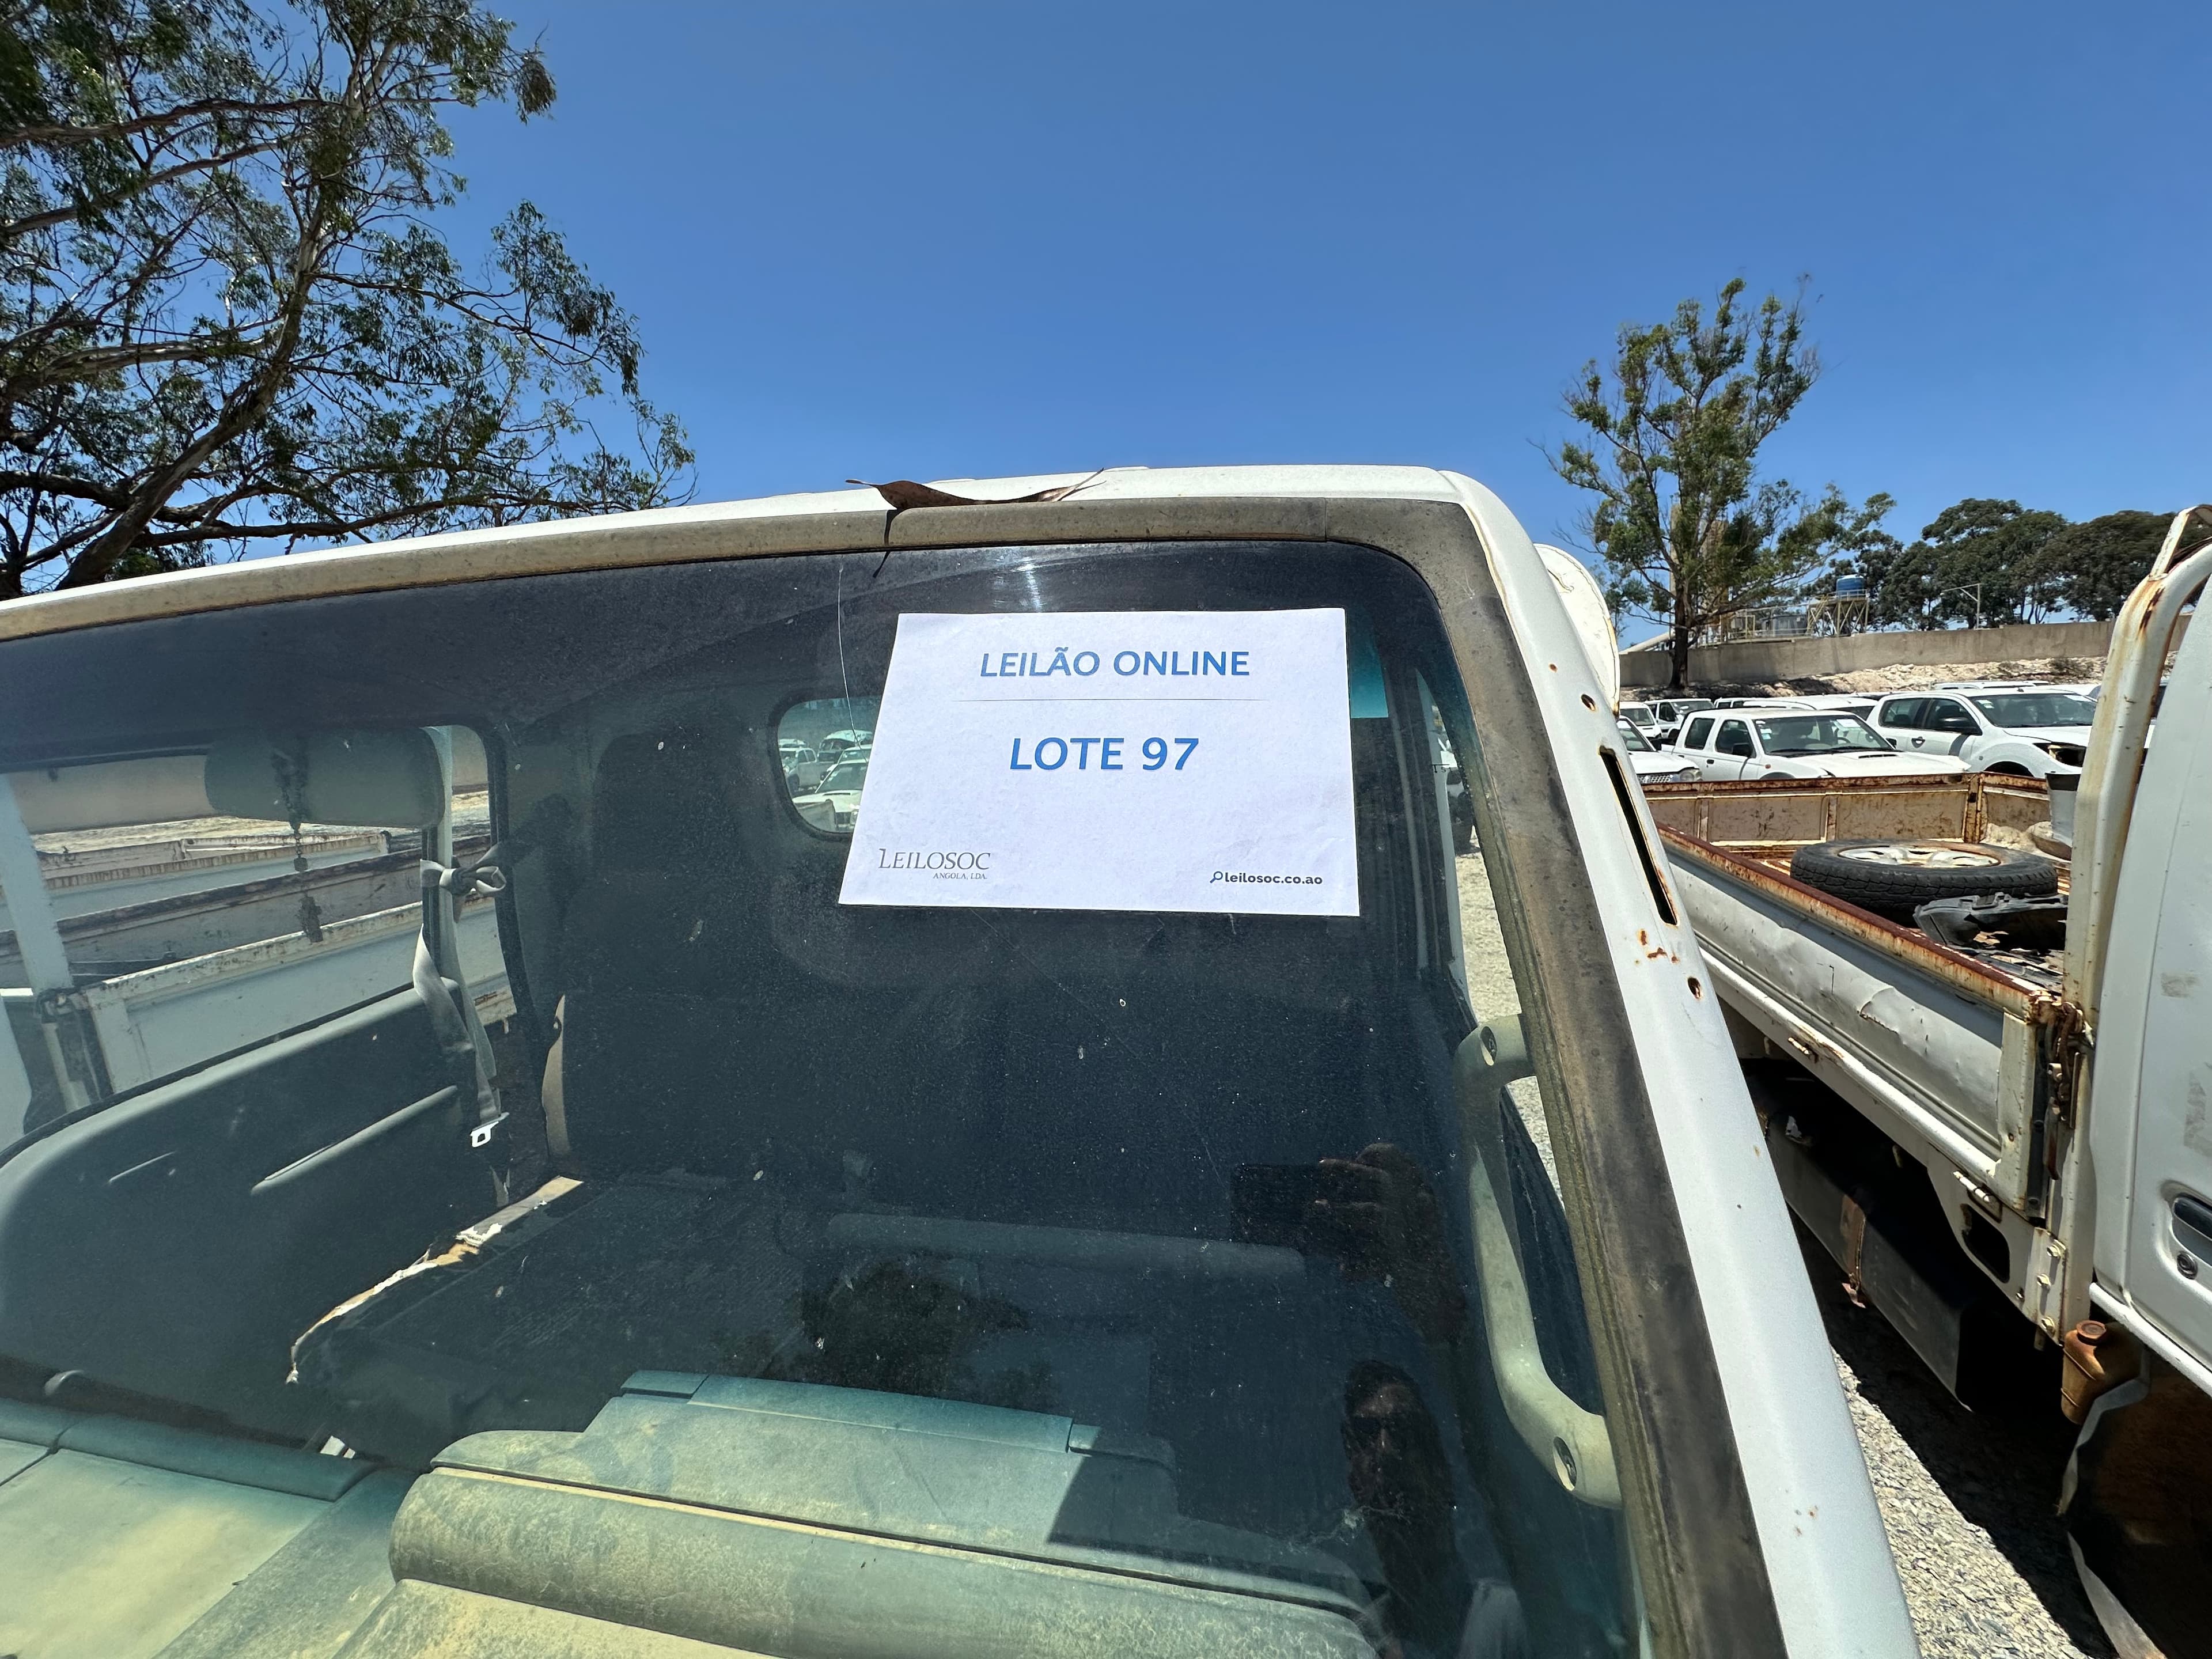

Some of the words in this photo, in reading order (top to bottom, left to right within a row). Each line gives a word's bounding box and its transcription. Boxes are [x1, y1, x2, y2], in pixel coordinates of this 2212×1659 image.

[980, 647, 1100, 677] LEILÃO
[1113, 651, 1249, 676] ONLINE
[1010, 737, 1124, 770] LOTE
[1142, 737, 1199, 771] 97
[878, 849, 991, 870] LEILOSOC
[1225, 872, 1323, 884] leilosoc.co.ao
